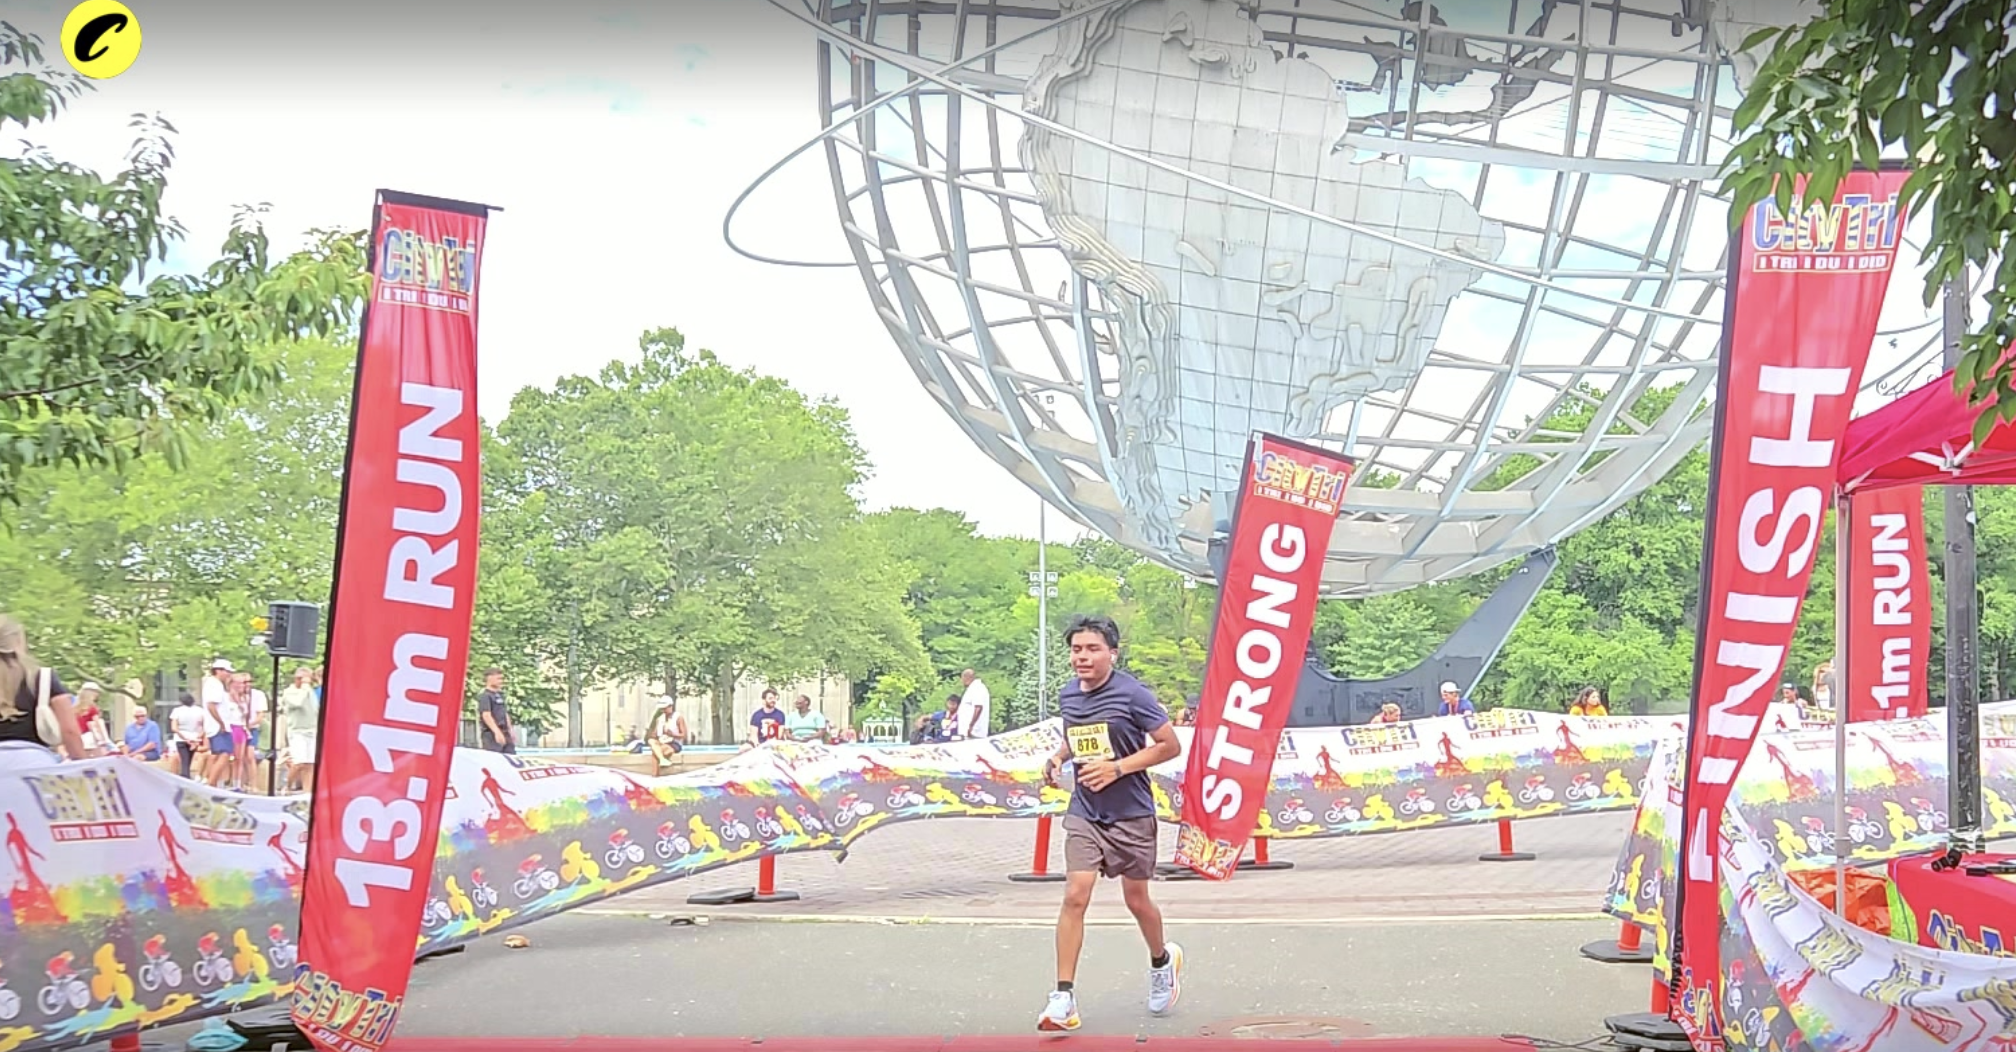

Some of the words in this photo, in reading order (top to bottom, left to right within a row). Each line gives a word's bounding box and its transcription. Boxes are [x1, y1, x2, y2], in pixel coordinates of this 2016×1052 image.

[1753, 193, 1899, 254] CityTri
[1770, 256, 1798, 269] TRI
[1815, 256, 1841, 269] DU
[1858, 255, 1887, 268] DID
[383, 382, 464, 609] RUN
[1254, 452, 1346, 503] CityTri
[1870, 513, 1912, 625] RUN
[1203, 523, 1306, 820] STRONG
[335, 634, 449, 908] 13.1m
[1077, 737, 1099, 752] 878
